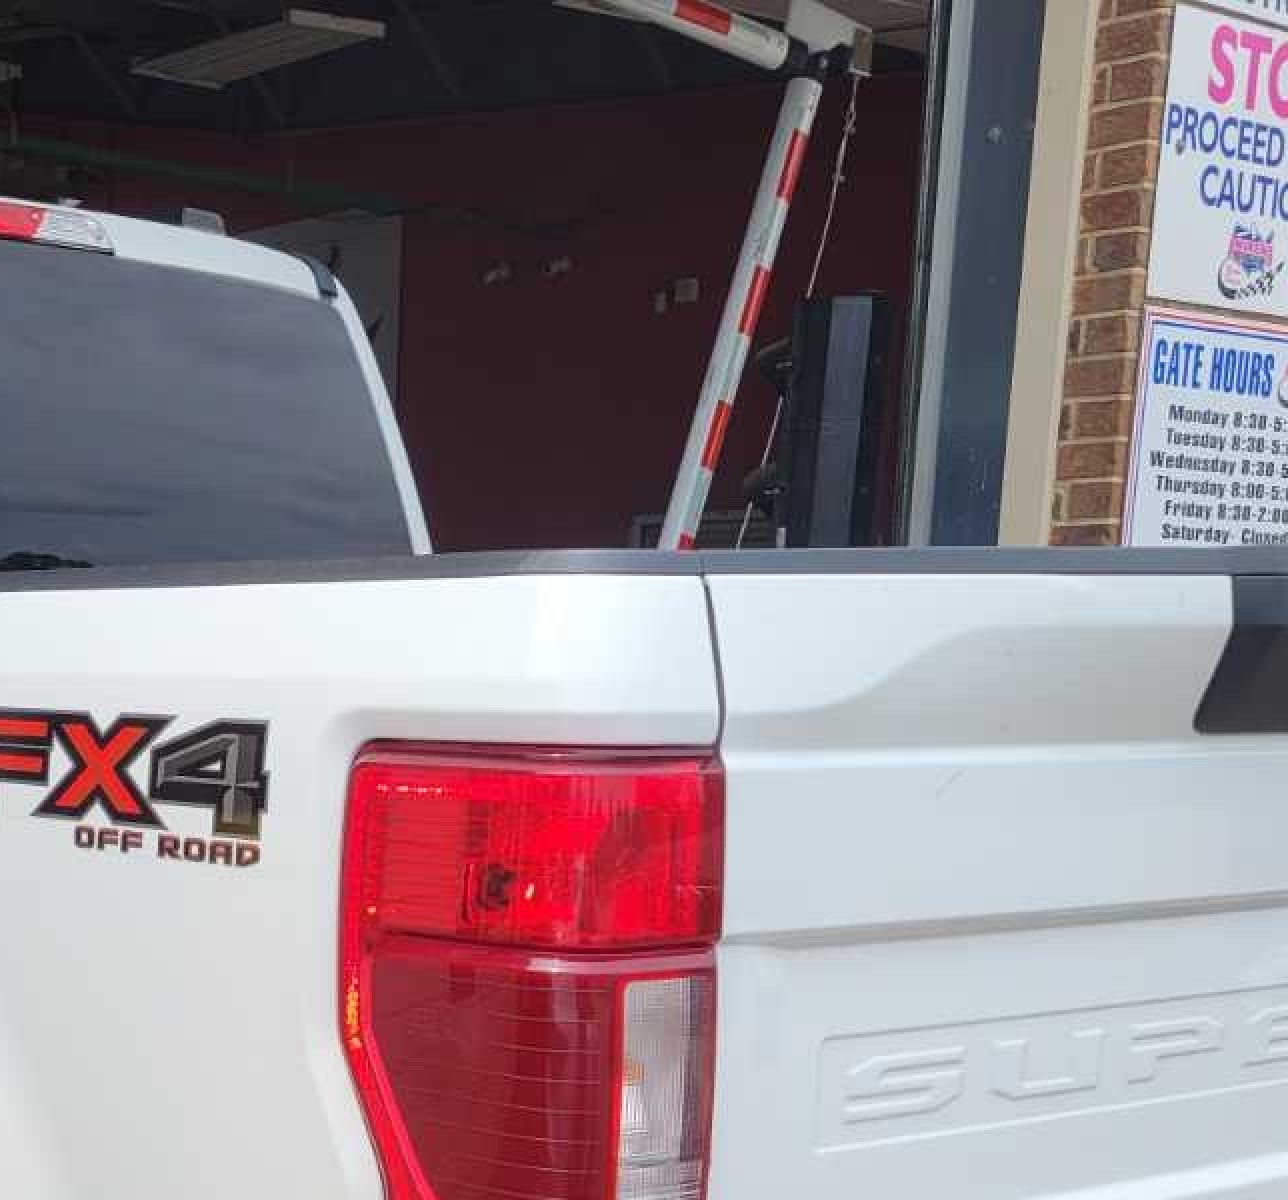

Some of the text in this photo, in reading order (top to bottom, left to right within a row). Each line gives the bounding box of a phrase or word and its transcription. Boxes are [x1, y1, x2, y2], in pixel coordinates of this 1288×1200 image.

[1165, 103, 1285, 168] PROCEED
[1153, 339, 1276, 398] GATE HOURS
[1168, 404, 1230, 429] Monday
[1166, 428, 1227, 451] Tuesday
[1149, 451, 1237, 476] Wednesday
[1156, 475, 1227, 499] Thursday
[1165, 500, 1213, 521] Friday
[1161, 524, 1230, 545] Saturday
[74, 825, 261, 867] OFF ROAD
